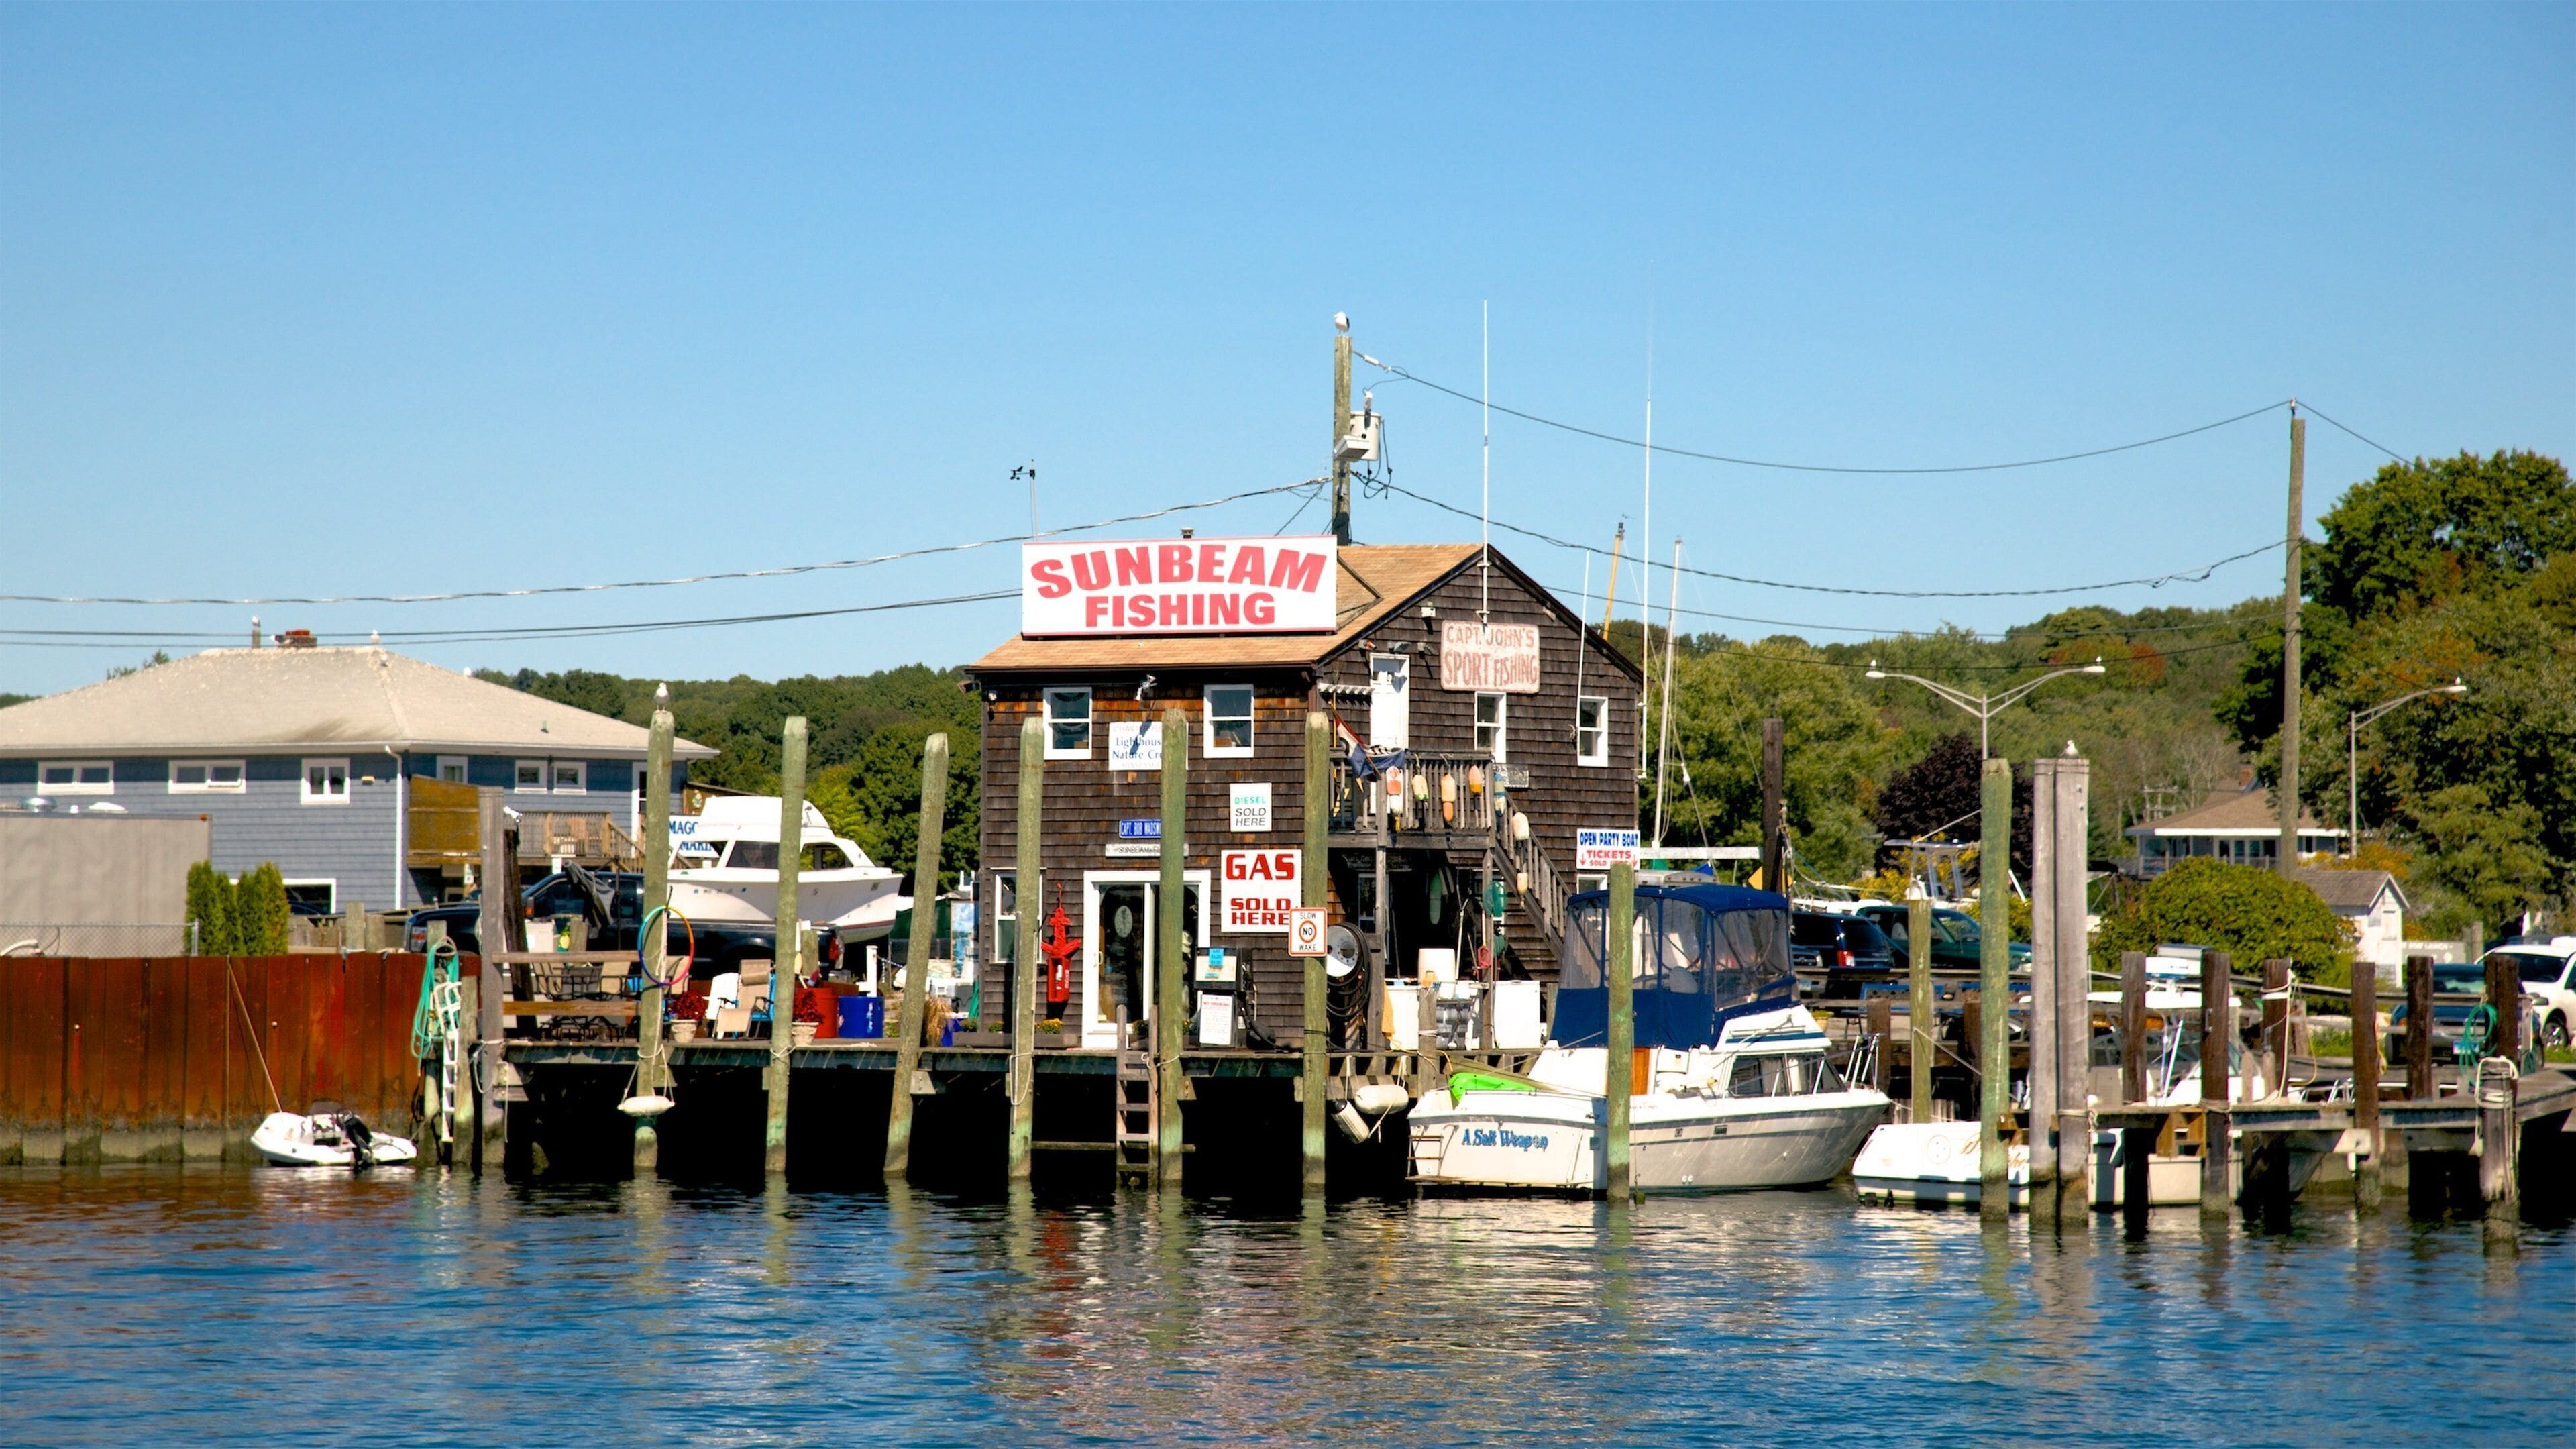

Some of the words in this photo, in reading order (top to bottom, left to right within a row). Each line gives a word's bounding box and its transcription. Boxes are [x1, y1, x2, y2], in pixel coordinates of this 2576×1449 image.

[1030, 544, 1327, 598] SUNBEAM
[1085, 592, 1275, 627] FISHING
[1446, 625, 1481, 645] CAPT.
[1487, 628, 1534, 647] JOHN'S
[1444, 651, 1489, 686] SPORT
[1494, 655, 1538, 686] FISHING
[1234, 796, 1266, 804] DIESEL
[1235, 808, 1267, 816] SOLD
[1236, 818, 1266, 826] HERE
[1580, 832, 1596, 845] OPEN
[1600, 833, 1619, 846] PARTY
[1622, 833, 1638, 847] BOAT
[1586, 849, 1631, 859] TICKETS
[1226, 854, 1294, 880] GAS
[1231, 898, 1291, 910] SOLD
[1232, 912, 1289, 925] HERE
[1300, 912, 1316, 920] SLOW
[1462, 1128, 1471, 1145] A
[1473, 1128, 1497, 1146] Salt
